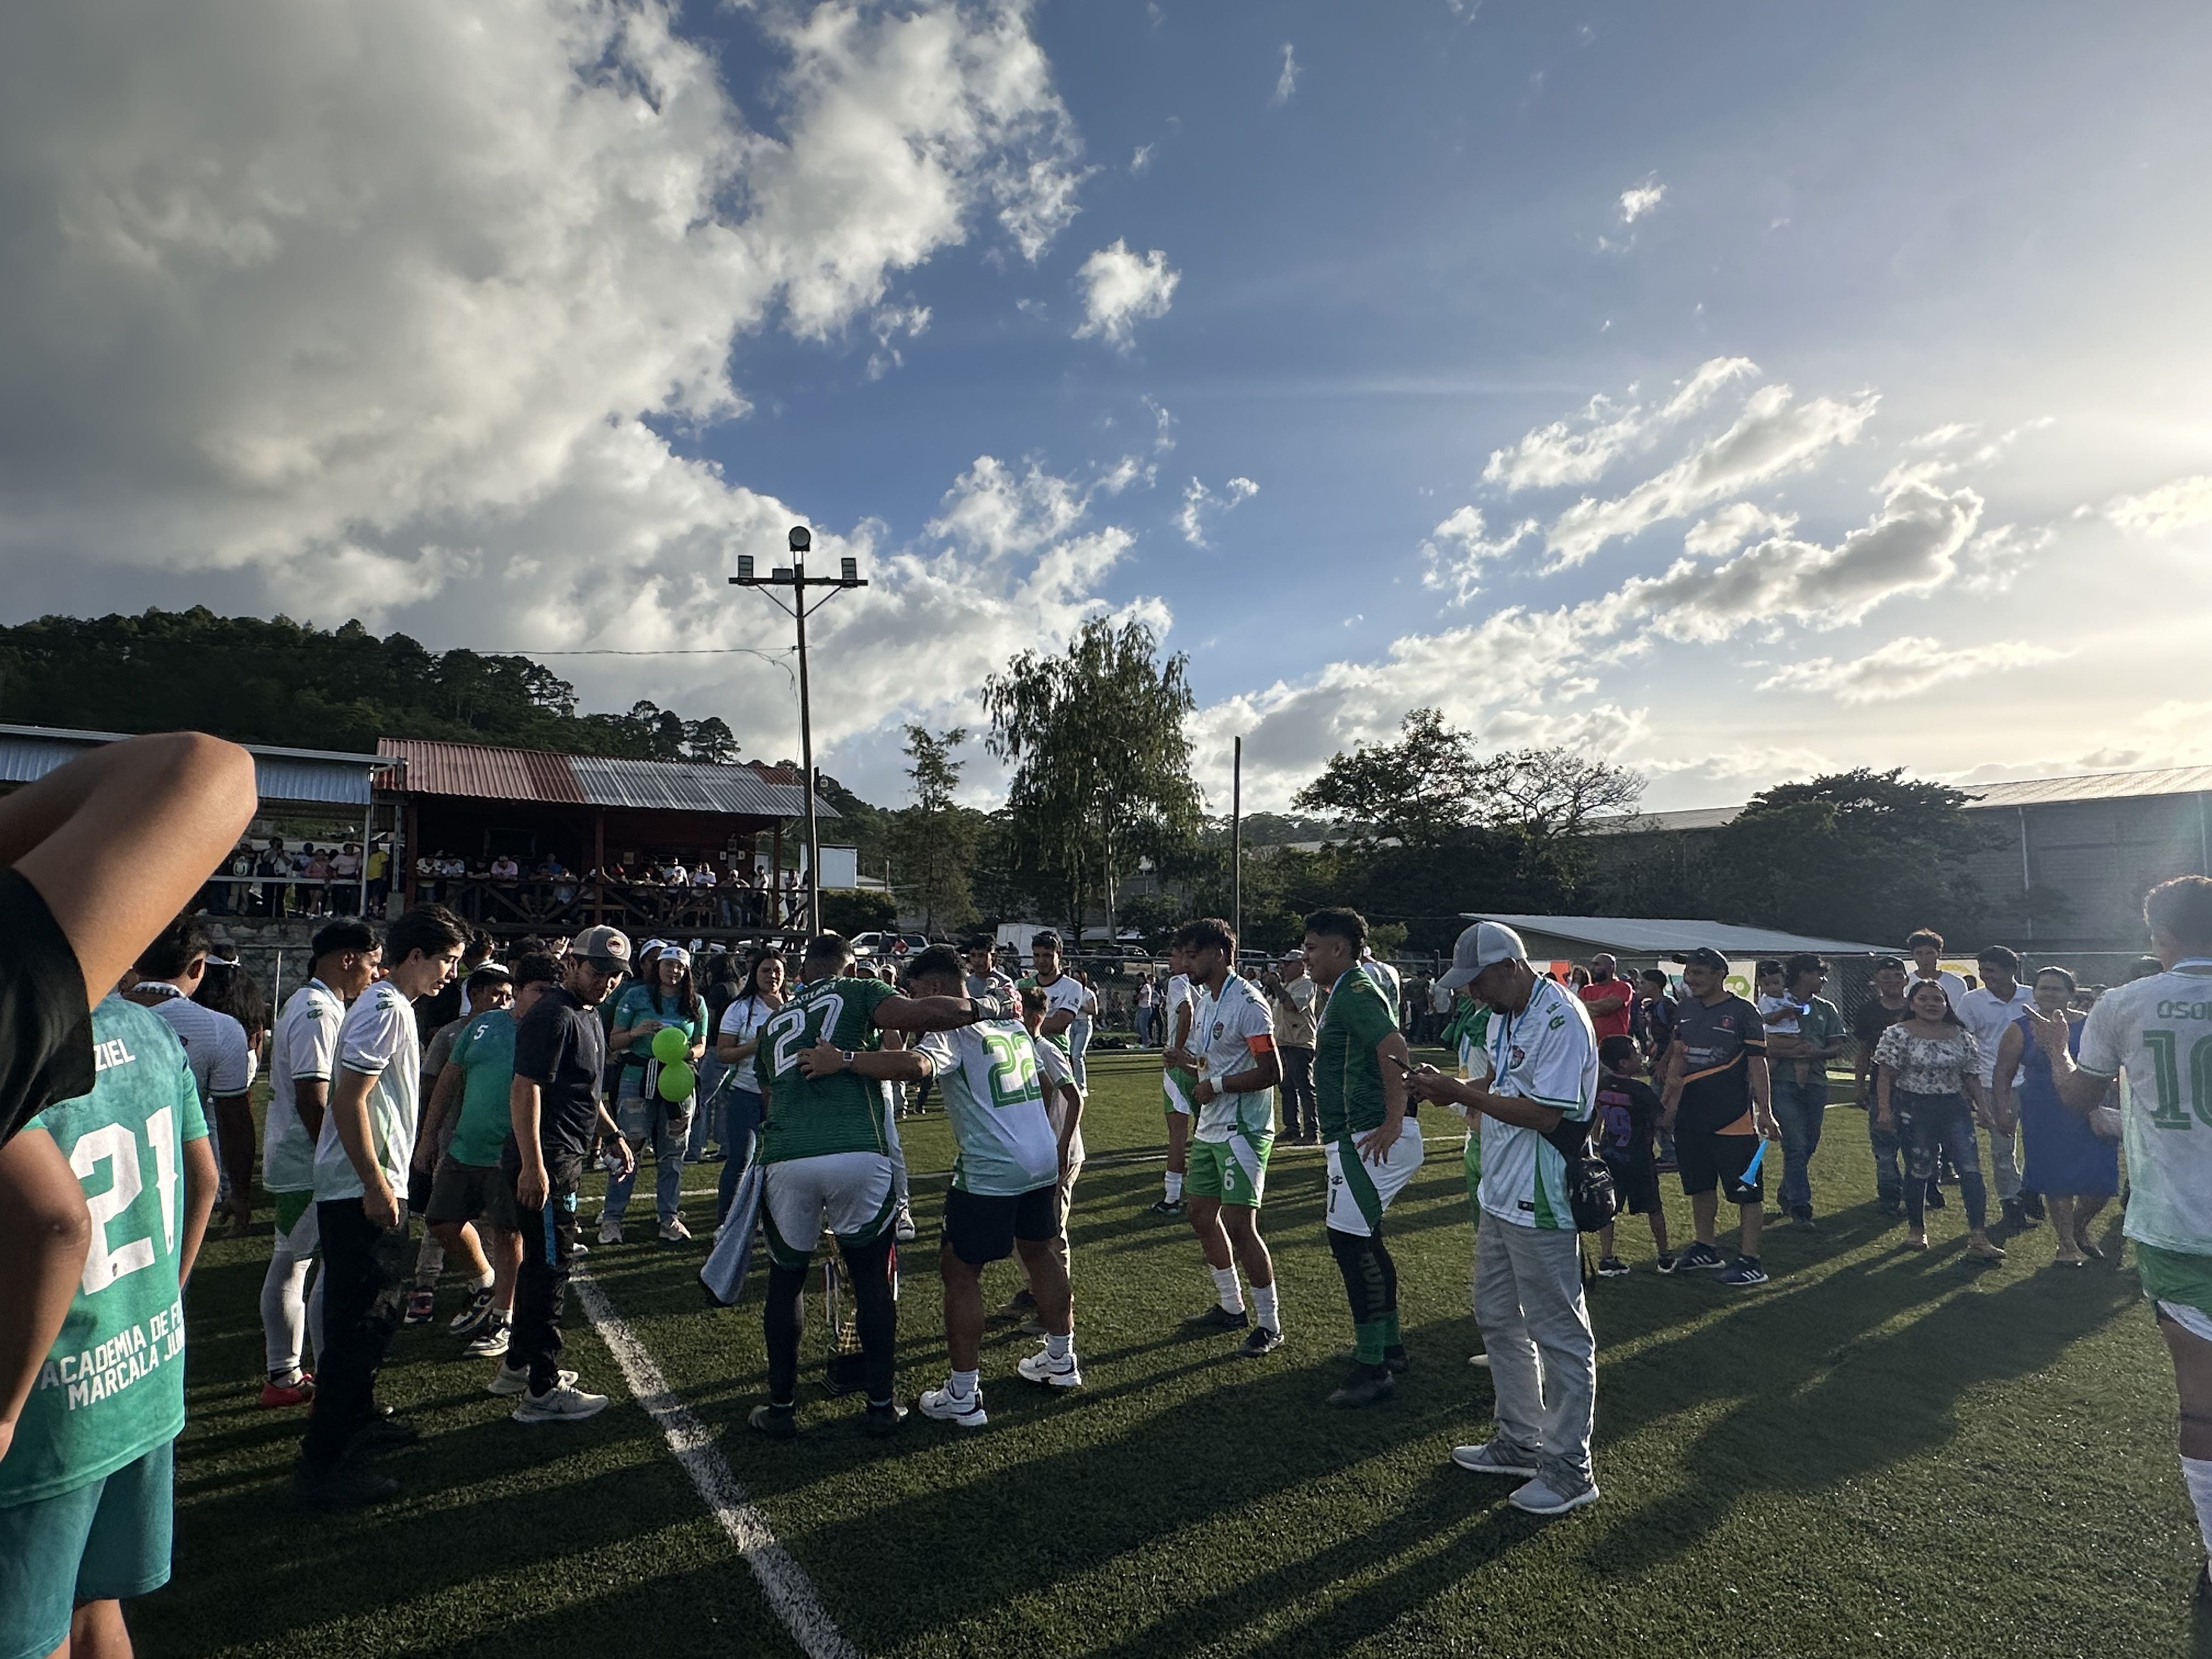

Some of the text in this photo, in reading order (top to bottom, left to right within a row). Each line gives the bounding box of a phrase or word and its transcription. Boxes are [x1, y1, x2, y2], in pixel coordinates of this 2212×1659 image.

[473, 1025, 489, 1040] 5
[768, 994, 844, 1077] 27
[982, 1031, 1042, 1108] 22
[70, 1105, 178, 1295] 21
[1224, 1169, 1235, 1190] 6
[40, 1325, 147, 1390] ACADEMIA
[149, 1310, 168, 1343] DE
[68, 1344, 159, 1410] MARCALA
